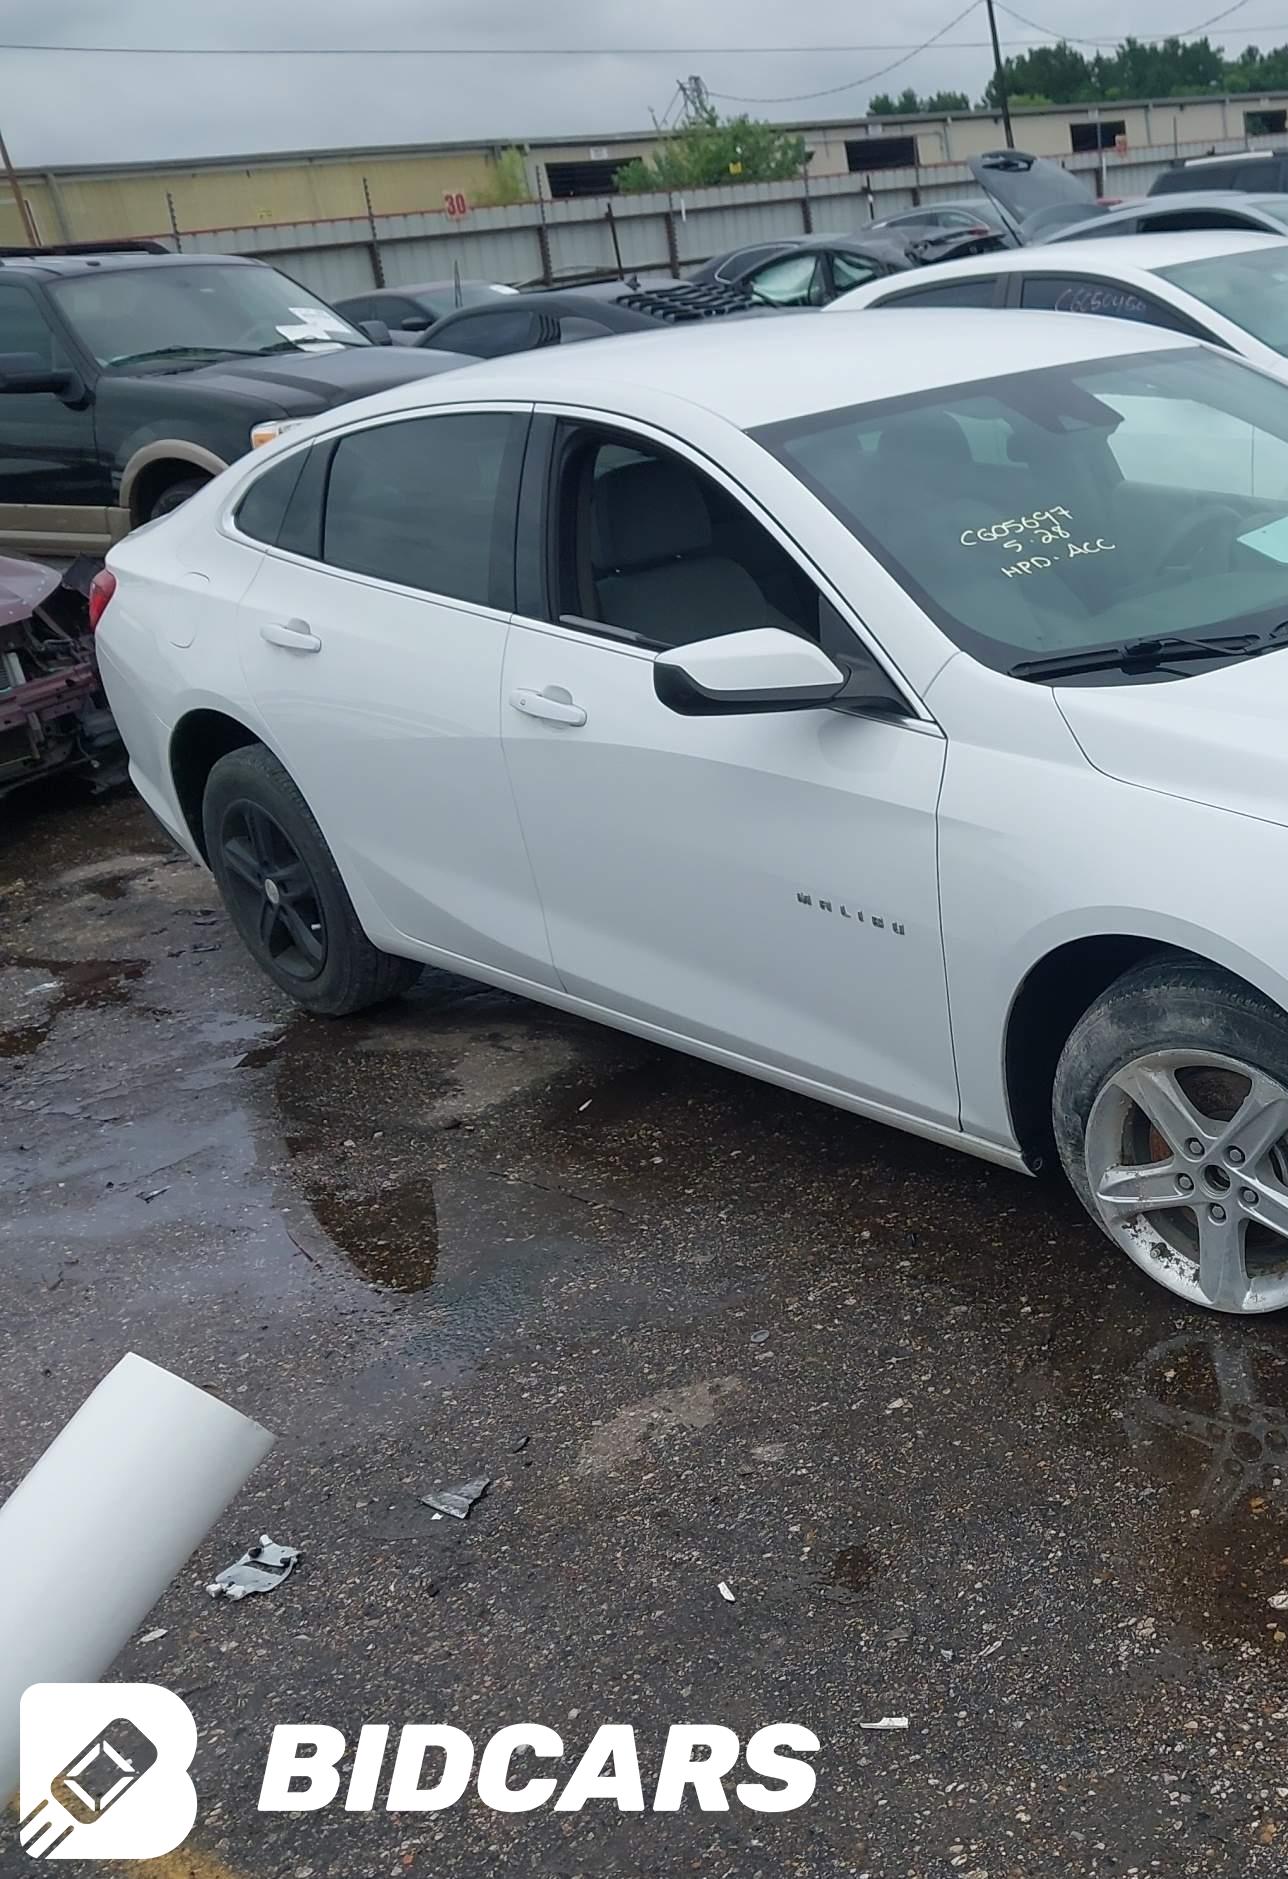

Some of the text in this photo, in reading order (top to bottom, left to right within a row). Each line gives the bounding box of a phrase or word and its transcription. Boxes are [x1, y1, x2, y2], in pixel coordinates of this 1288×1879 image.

[445, 194, 466, 215] 30
[1067, 538, 1116, 558] ACC
[796, 892, 905, 935] MALIBU
